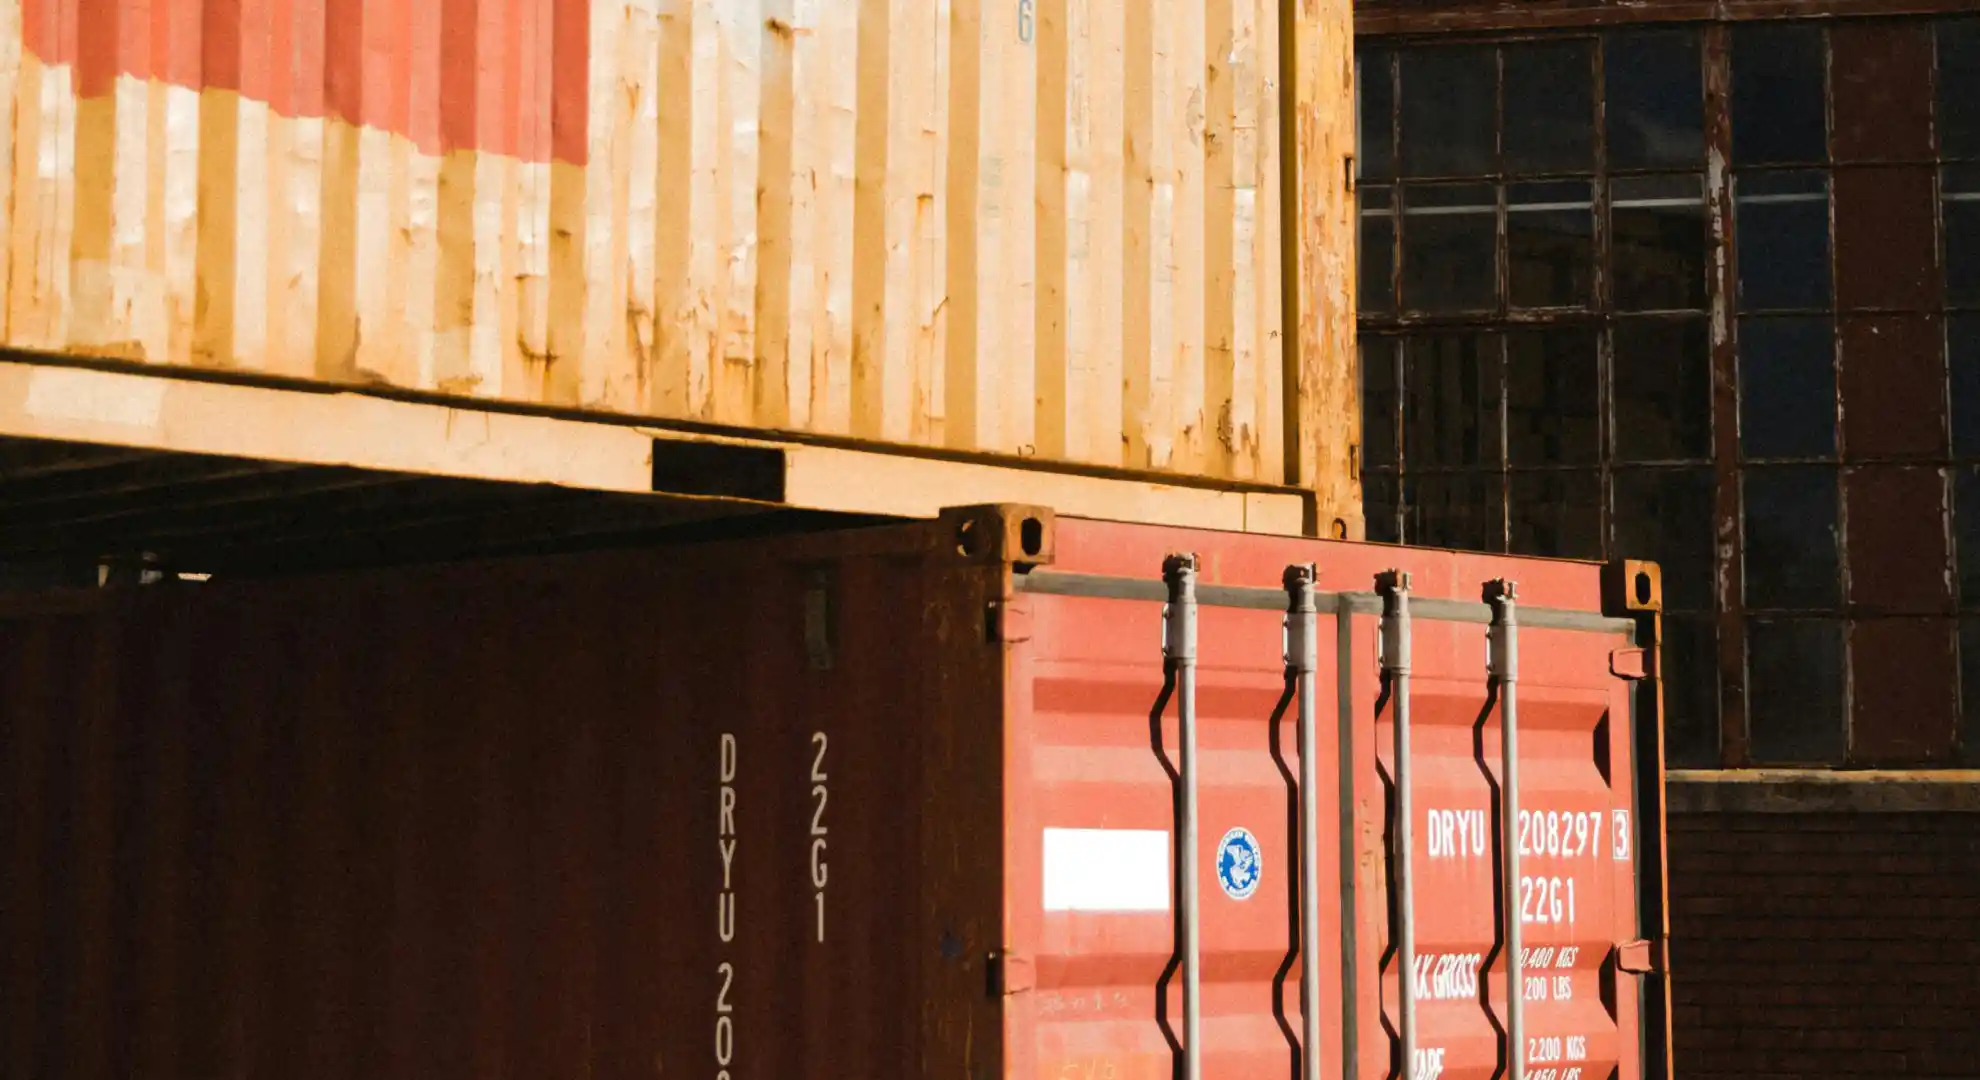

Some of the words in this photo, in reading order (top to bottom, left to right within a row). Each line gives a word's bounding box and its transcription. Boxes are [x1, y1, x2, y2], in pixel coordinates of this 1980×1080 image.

[719, 733, 736, 942] DRYU
[811, 731, 828, 943] 22G1
[1428, 809, 1485, 857] DRYU
[1519, 810, 1601, 857] 208297
[1614, 811, 1628, 858] 3
[1521, 876, 1574, 924] 22G1
[1433, 953, 1481, 999] GROSS
[1555, 946, 1579, 968] KGS
[1553, 975, 1572, 1000] LBS
[715, 962, 733, 1080] 20
[1529, 1036, 1561, 1062] 2.200
[1566, 1035, 1586, 1061] KGS
